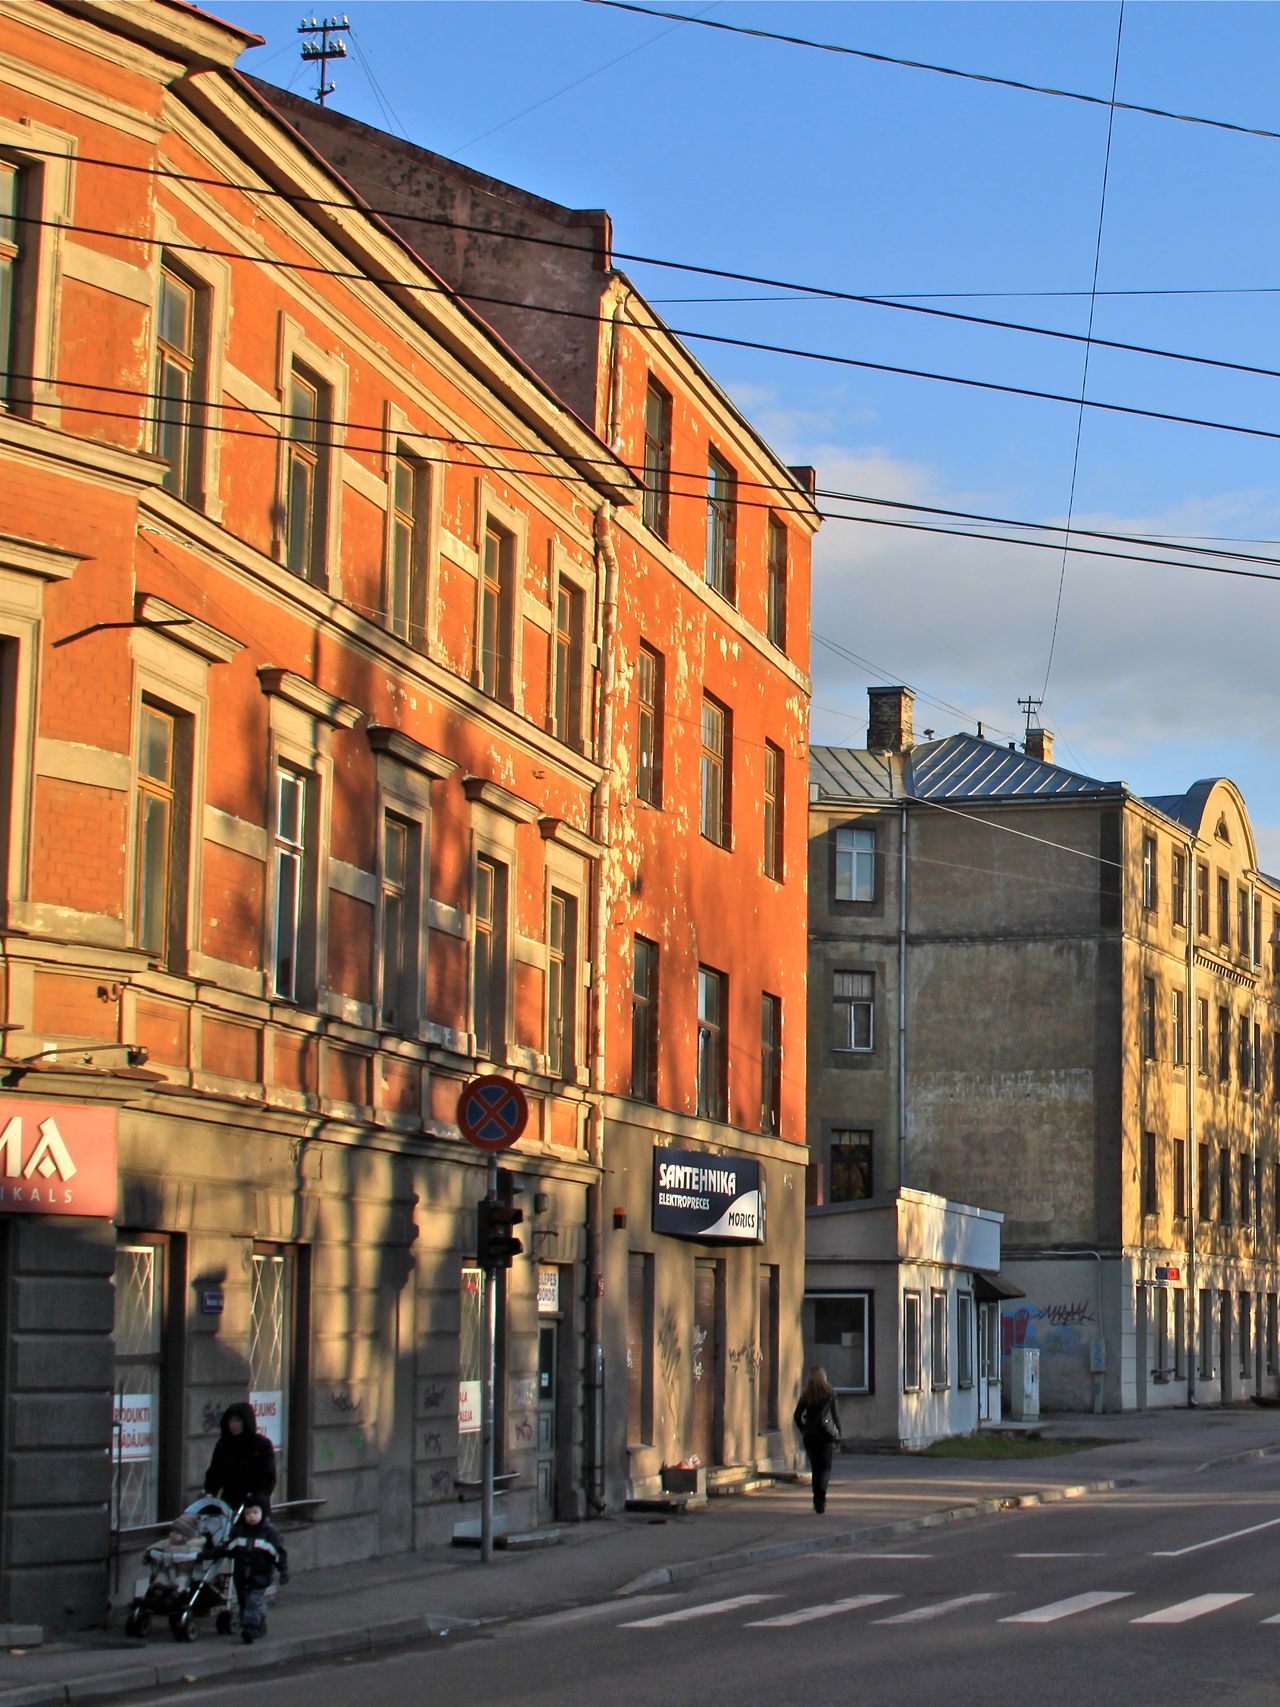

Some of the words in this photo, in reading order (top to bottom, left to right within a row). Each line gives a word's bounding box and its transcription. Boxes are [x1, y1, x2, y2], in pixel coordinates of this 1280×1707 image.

[659, 1163, 736, 1196] SANTEHNIKA
[658, 1192, 710, 1210] ELEKTROPRECES
[728, 1212, 755, 1228] MORICS
